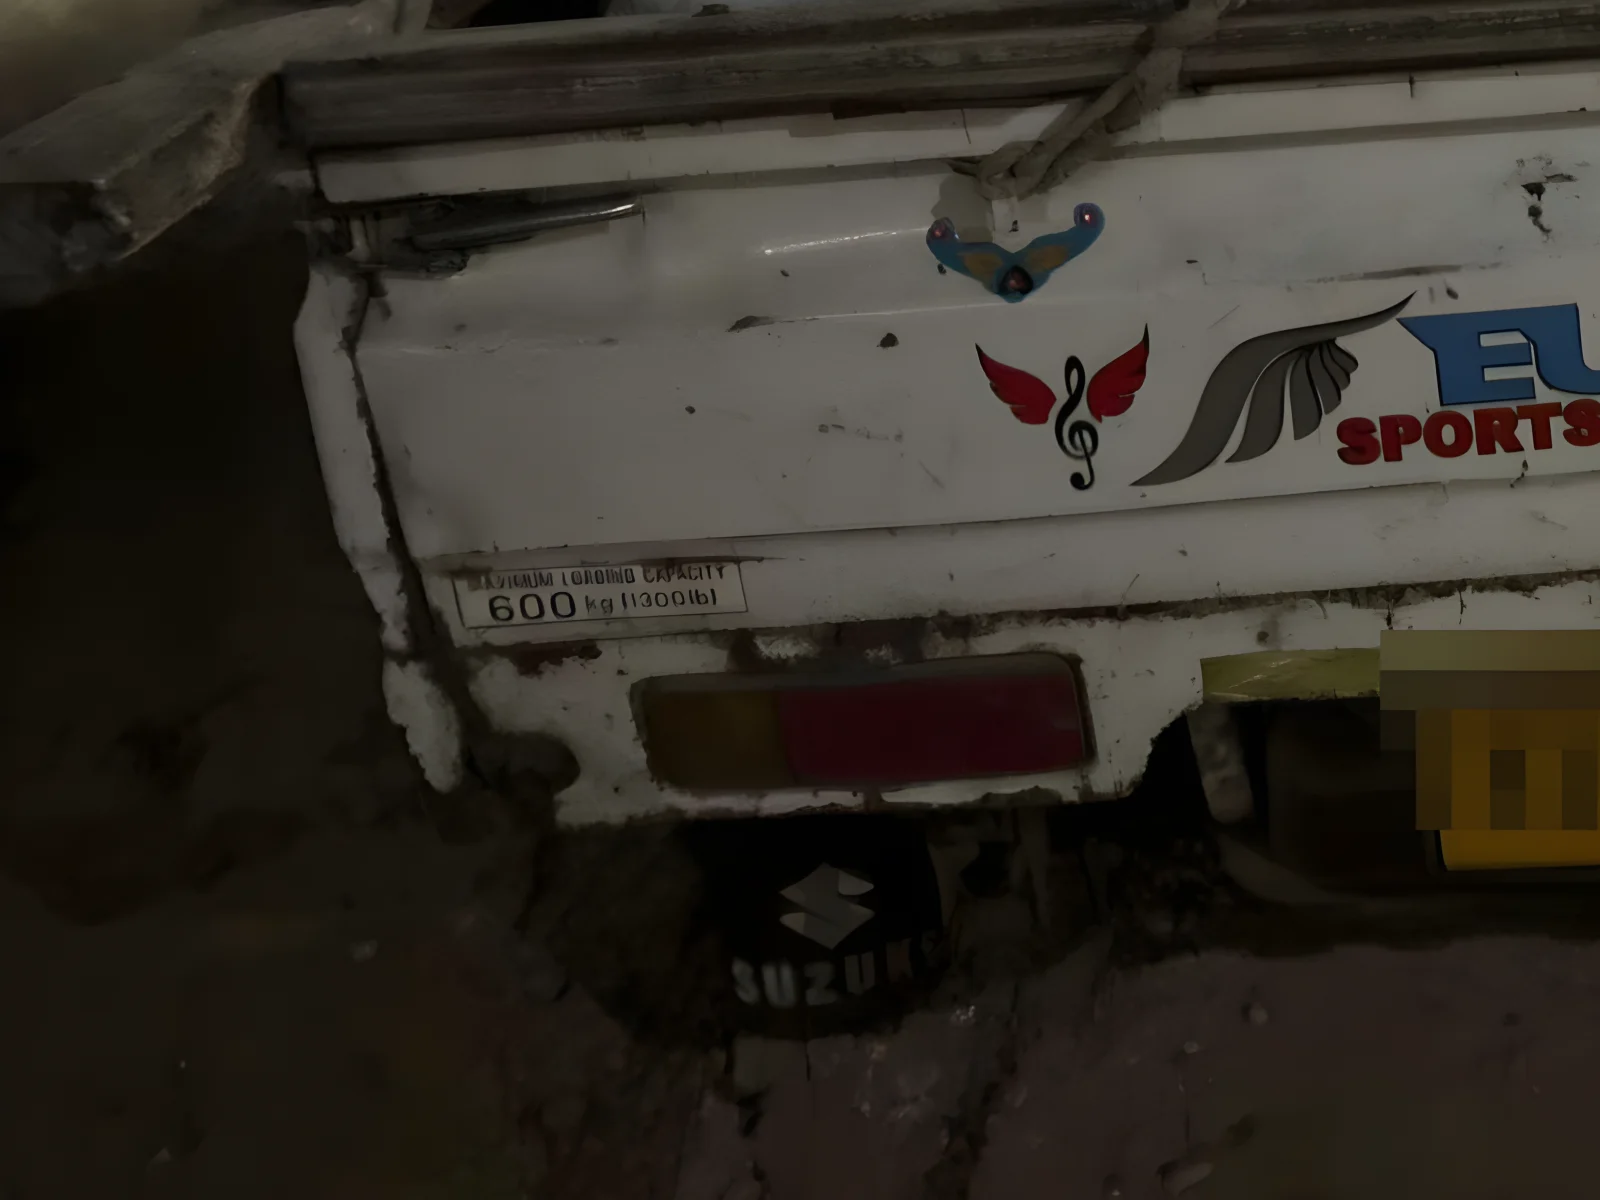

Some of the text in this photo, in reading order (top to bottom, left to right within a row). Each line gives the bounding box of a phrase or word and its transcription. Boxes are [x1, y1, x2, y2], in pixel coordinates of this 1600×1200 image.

[642, 564, 725, 584] CAPACITY
[488, 591, 577, 622] 600
[585, 593, 613, 614] kg
